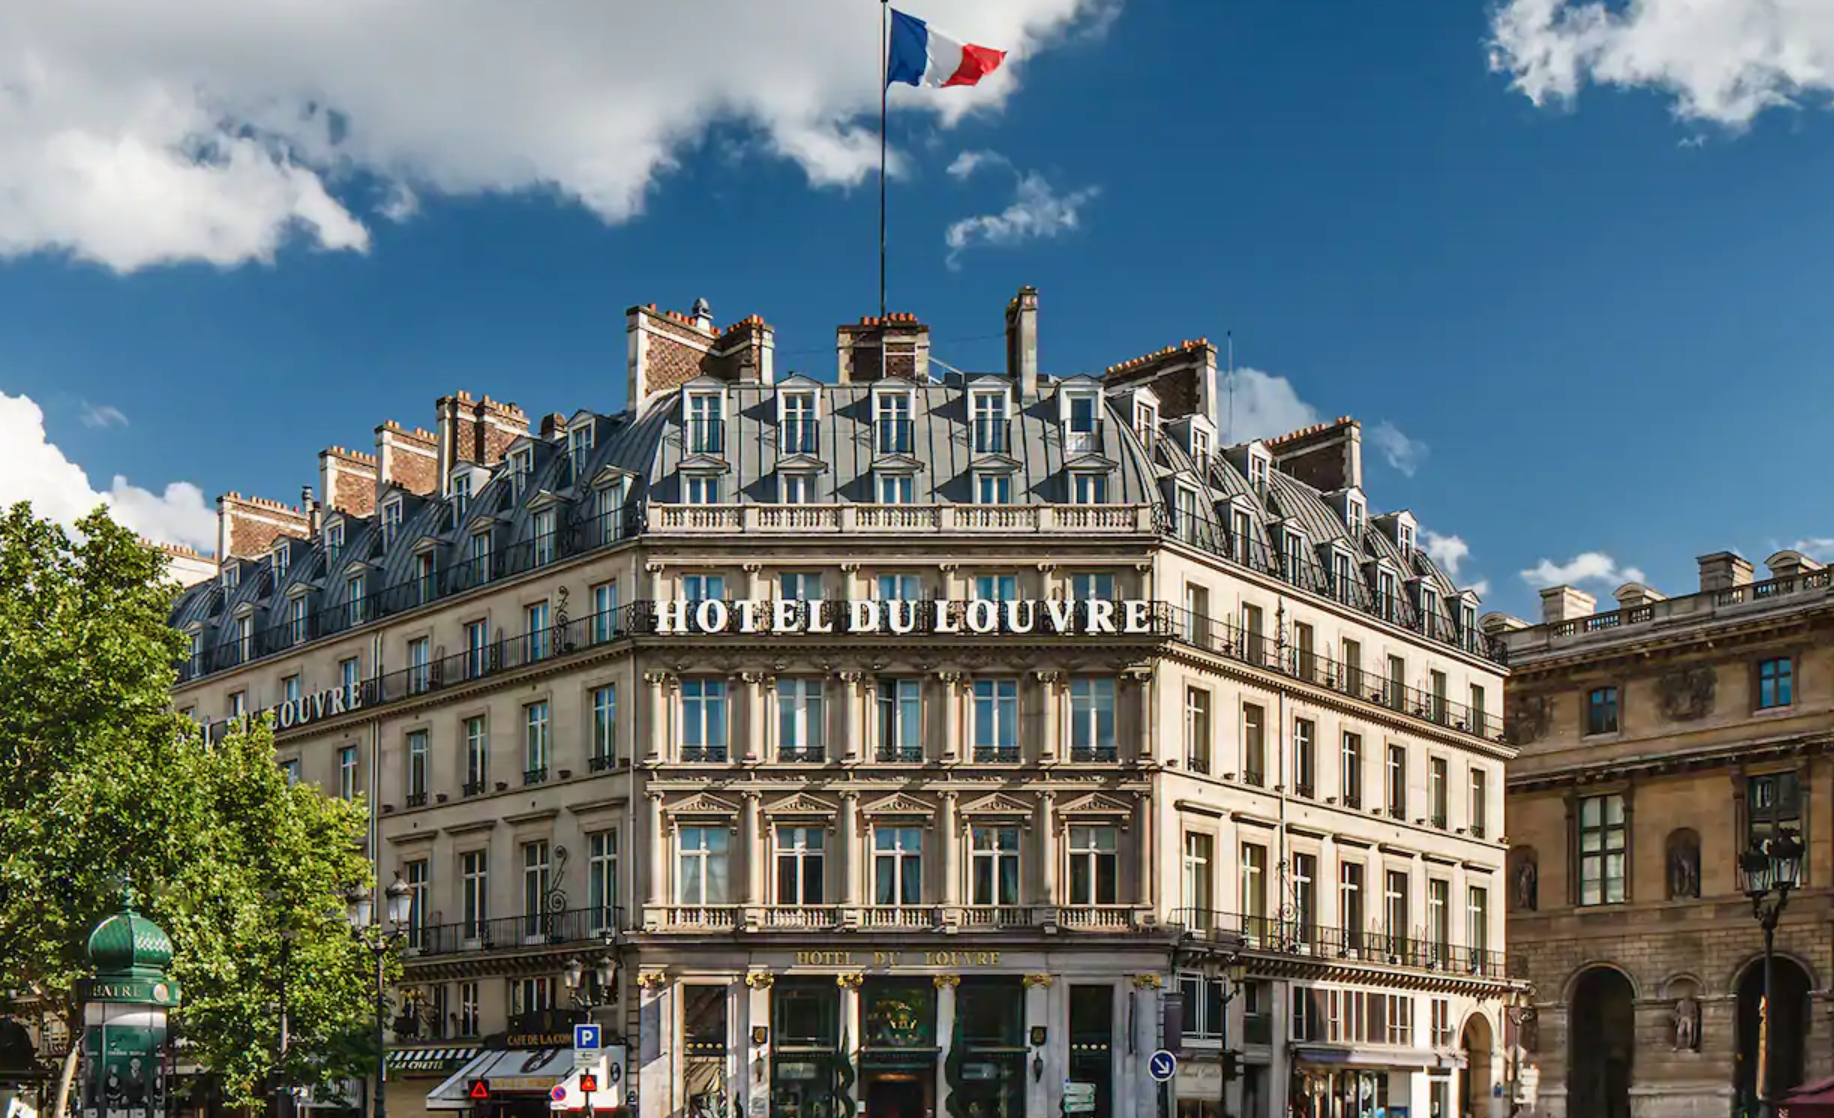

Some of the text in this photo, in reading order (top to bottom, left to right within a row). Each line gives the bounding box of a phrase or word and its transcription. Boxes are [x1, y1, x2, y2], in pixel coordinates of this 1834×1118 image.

[653, 599, 1154, 634] HOTEL DU LOUVRE
[874, 951, 901, 965] DU
[925, 951, 1001, 965] LOUVRE
[581, 1029, 594, 1046] P
